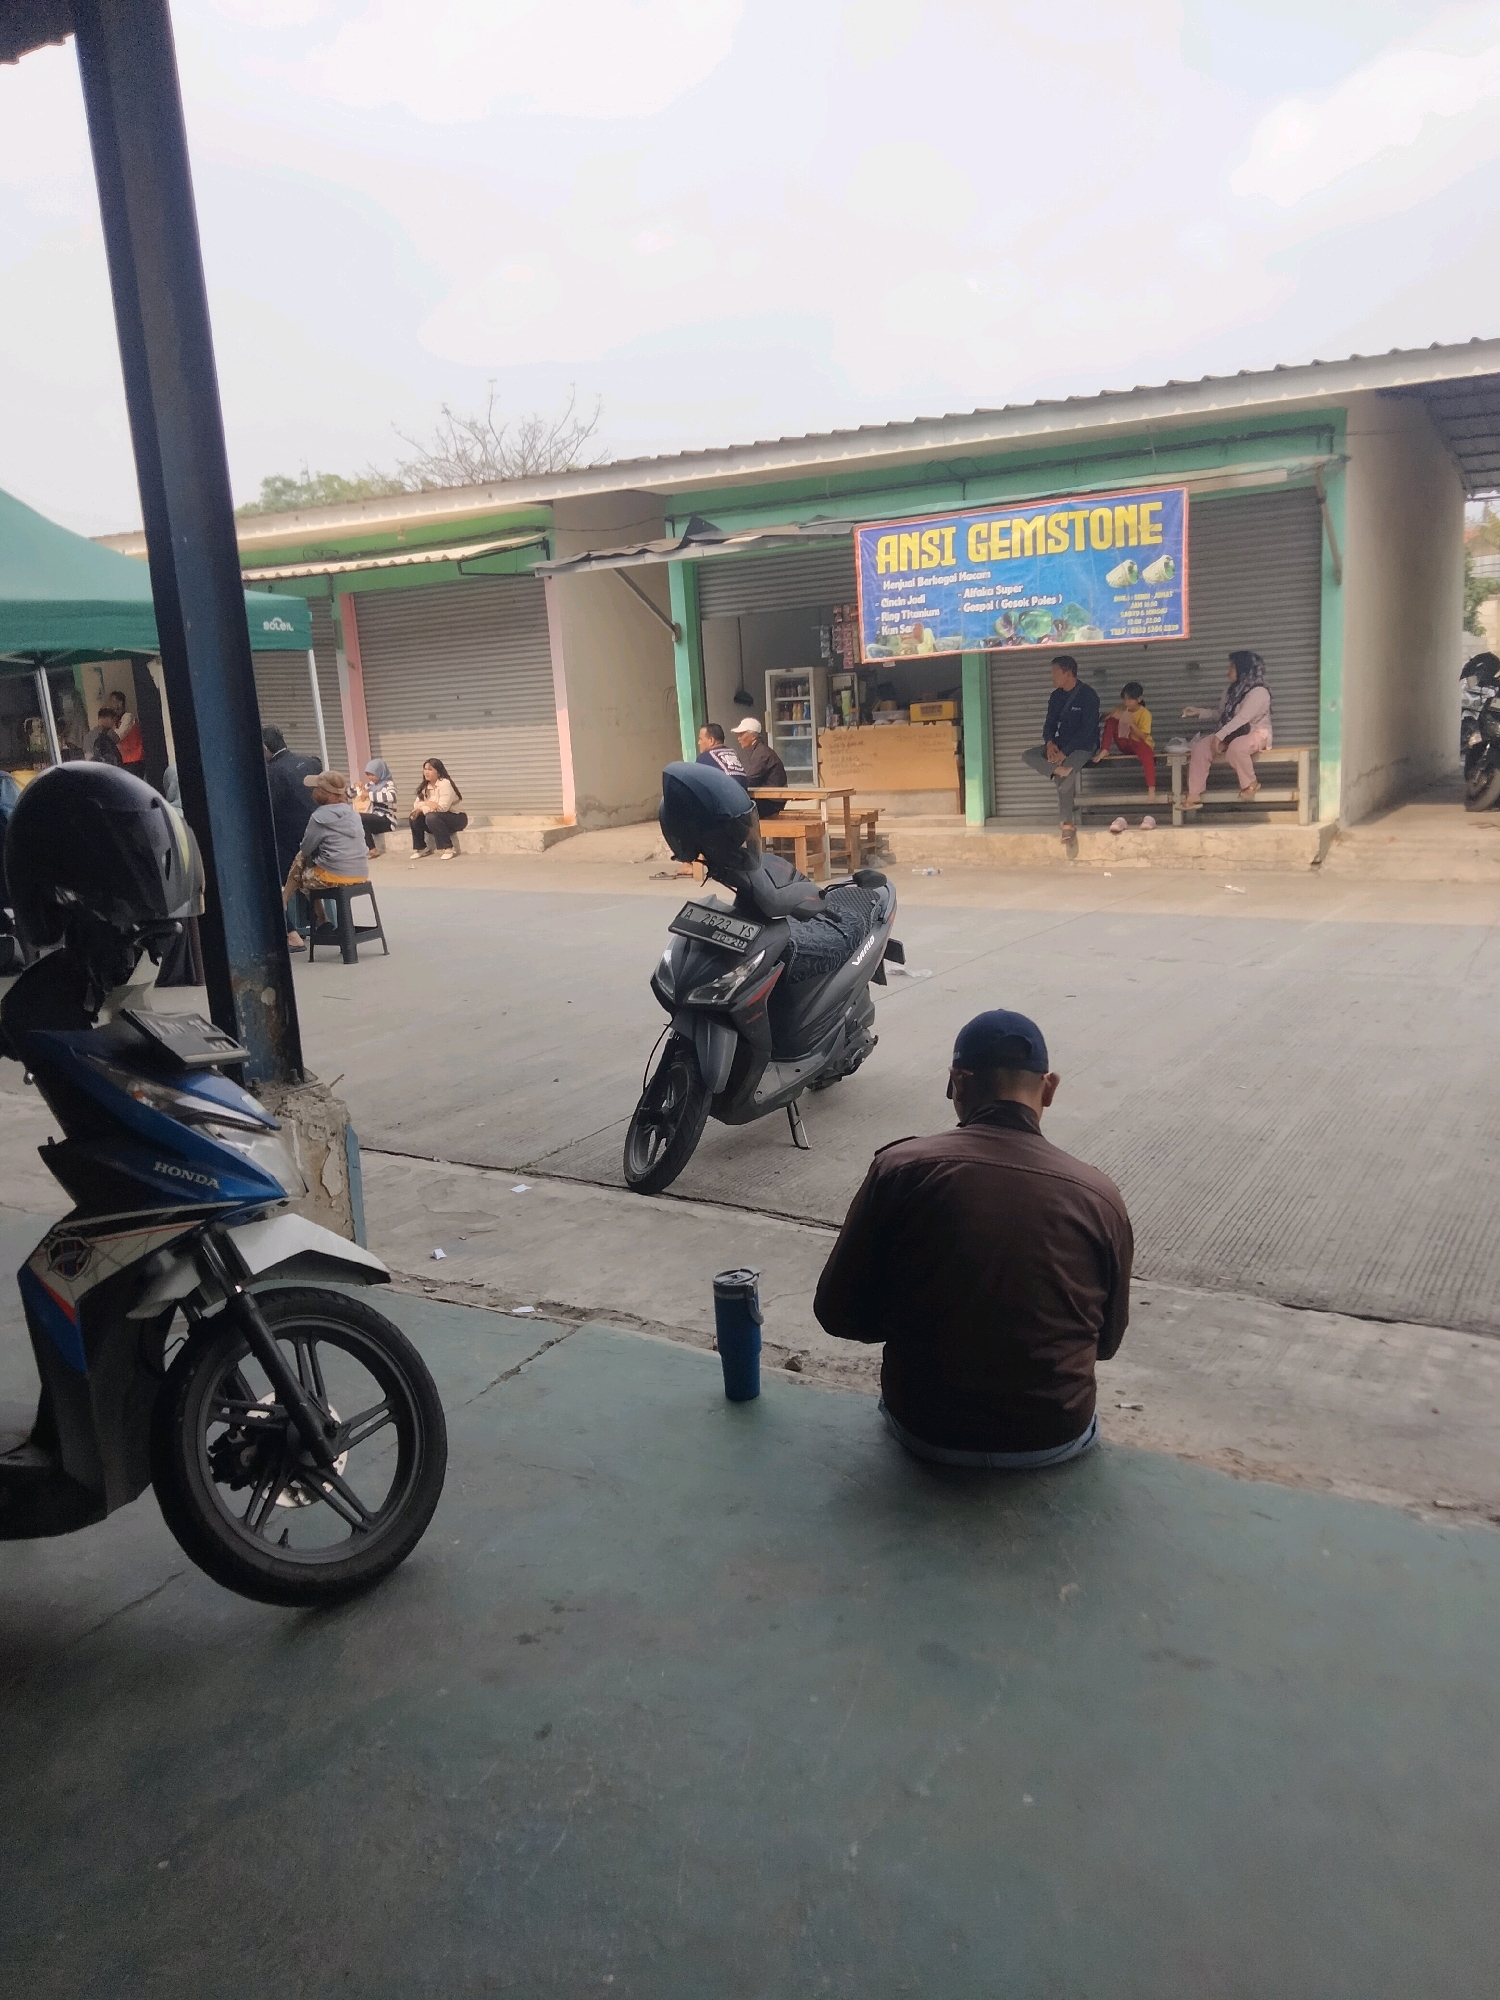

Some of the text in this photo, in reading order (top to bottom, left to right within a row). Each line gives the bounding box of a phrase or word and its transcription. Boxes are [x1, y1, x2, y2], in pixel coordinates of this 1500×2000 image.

[875, 501, 1163, 575] ANSI GEMSTONE
[882, 570, 992, 592] Menjual Berbagai Macam
[995, 584, 1024, 596] Super
[880, 597, 906, 608] Cincin
[907, 594, 926, 605] Jadi
[963, 601, 994, 613] Gospol
[1001, 598, 1029, 609] Gosok
[1031, 595, 1057, 607] Poles
[881, 611, 900, 623] Ring
[901, 608, 940, 620] Titanium
[881, 625, 898, 636] Kun
[684, 908, 755, 938] A 2623 YS
[851, 934, 875, 966] VARIO
[153, 1161, 220, 1190] HONDA
